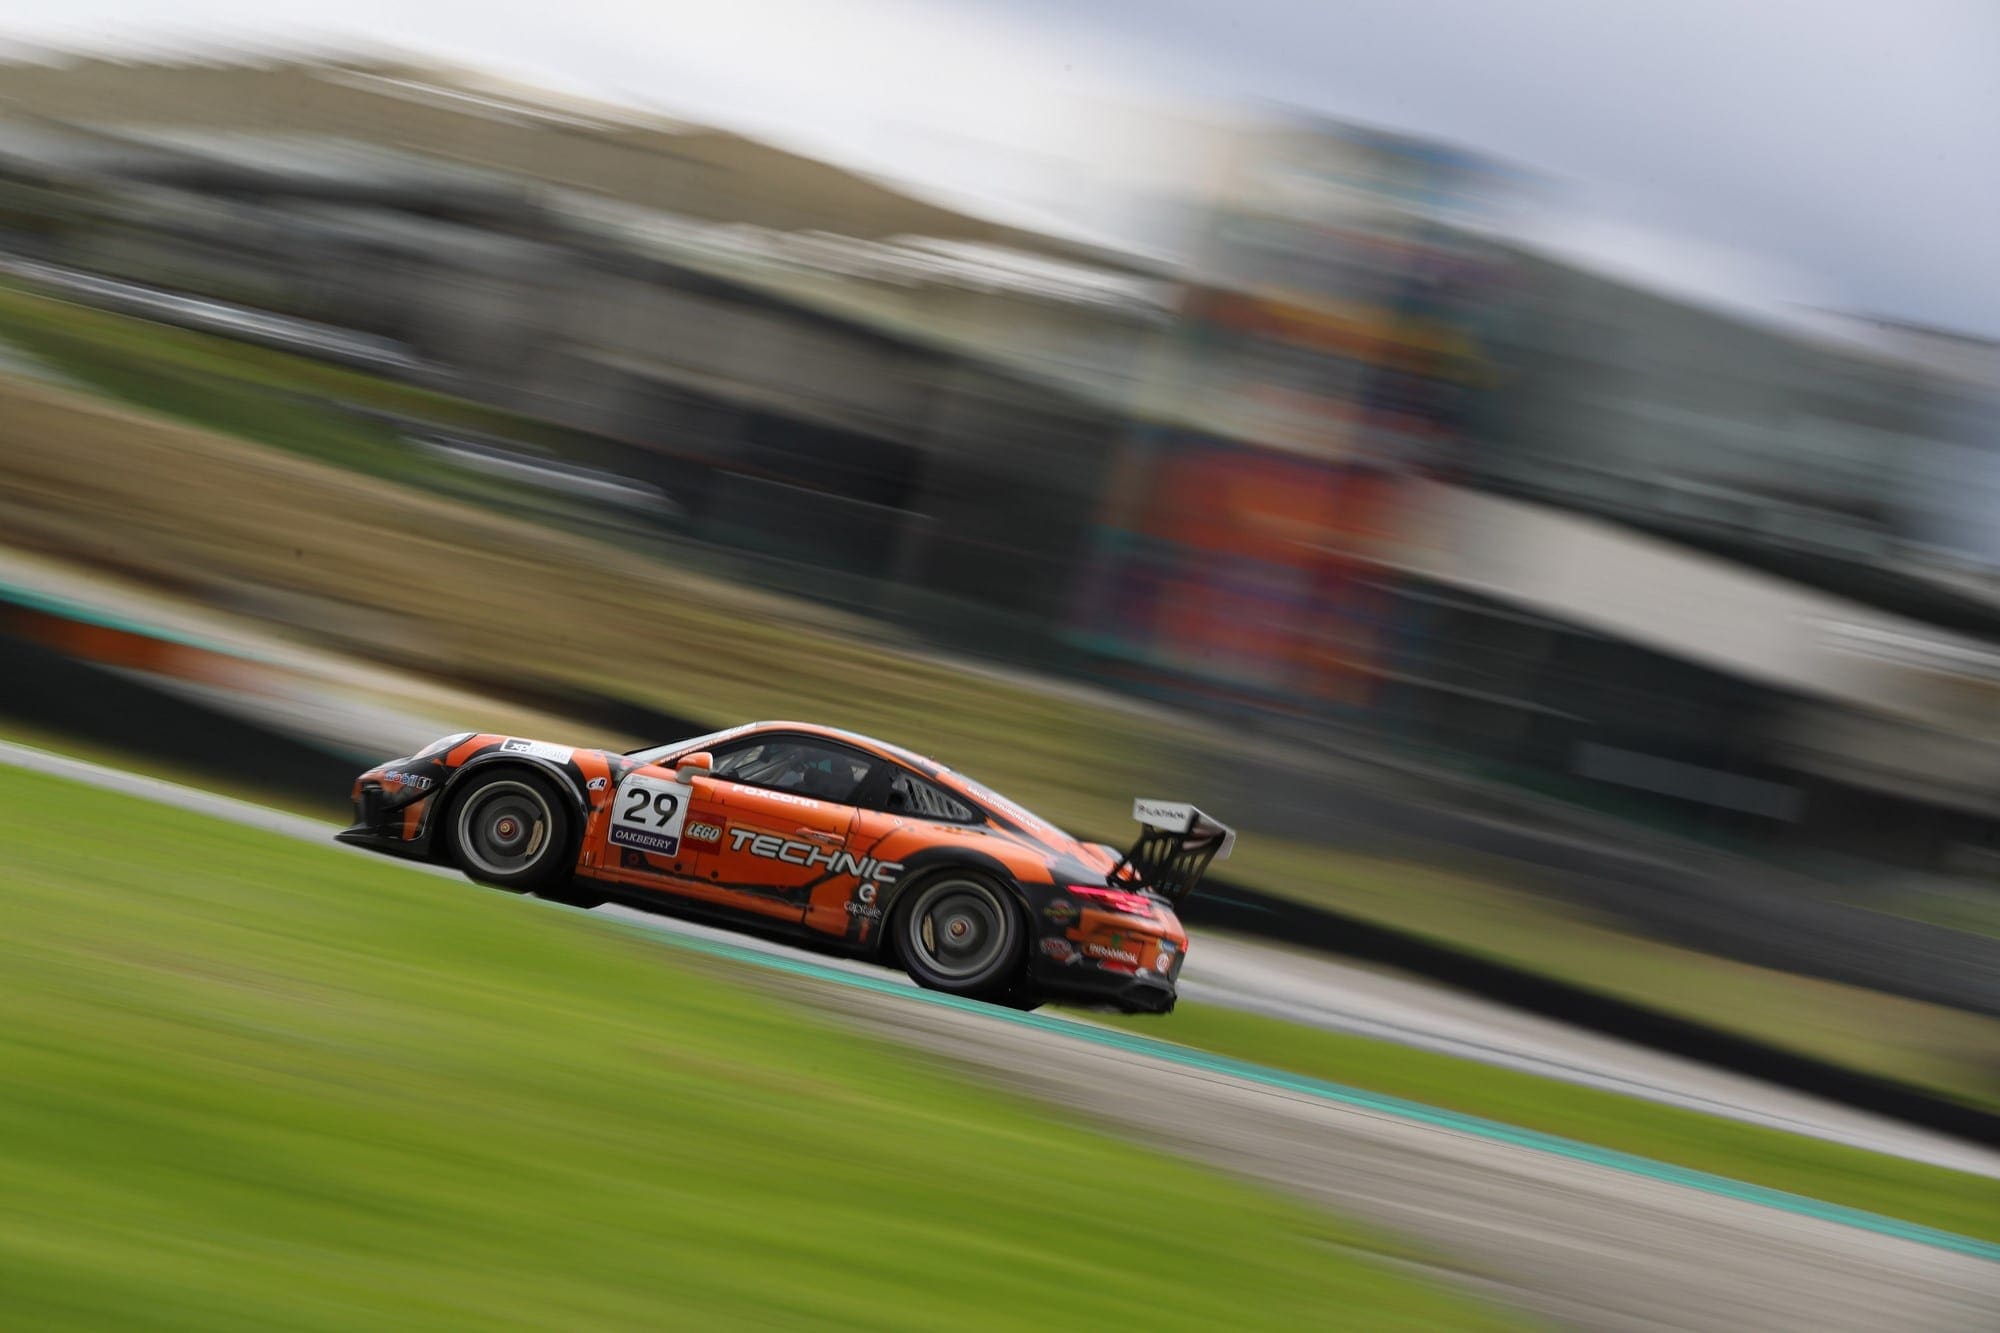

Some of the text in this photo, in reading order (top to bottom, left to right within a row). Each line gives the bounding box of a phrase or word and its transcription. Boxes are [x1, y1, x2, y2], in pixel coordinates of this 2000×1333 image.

[624, 788, 678, 827] 29
[615, 830, 672, 850] OAKBERRY
[687, 822, 720, 842] LEGO
[730, 829, 904, 883] TECHNIC
